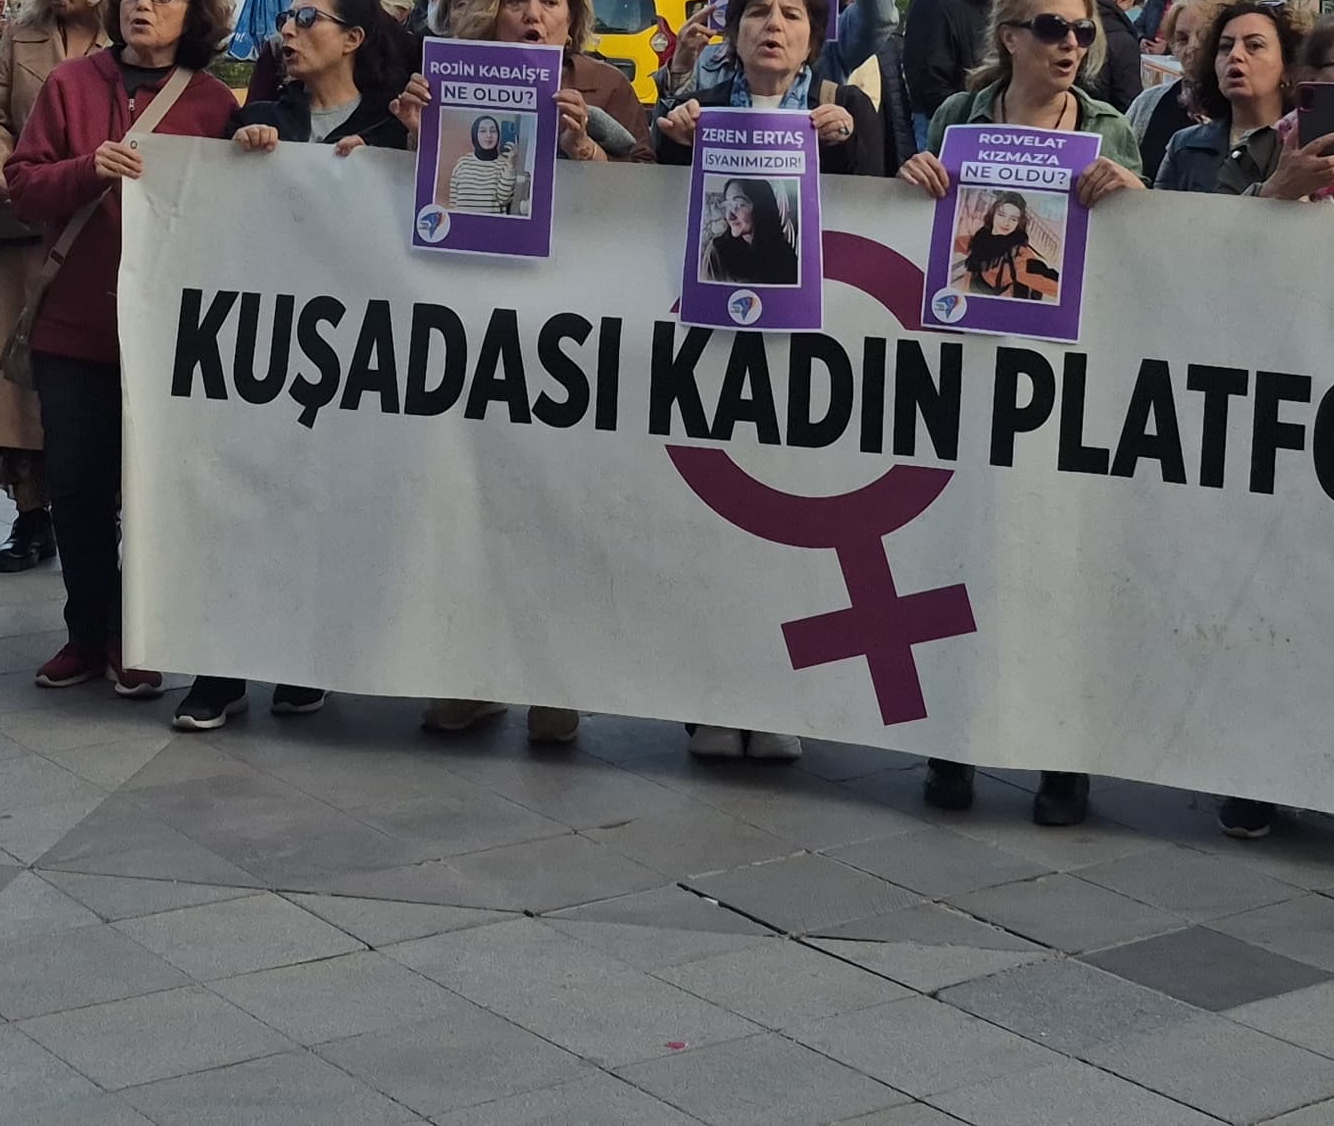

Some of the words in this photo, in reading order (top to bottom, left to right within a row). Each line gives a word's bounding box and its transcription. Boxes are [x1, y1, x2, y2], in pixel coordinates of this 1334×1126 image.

[430, 60, 475, 77] ROJİN
[479, 65, 551, 83] KABAİŞ'E
[444, 85, 468, 100] NE
[473, 87, 533, 105] OLDU?
[702, 127, 747, 144] ZEREN
[752, 131, 805, 149] ERTAŞ
[978, 133, 1067, 149] ROJVELAT
[977, 150, 1060, 165] KIZMAZ'A
[965, 165, 991, 178] NE
[998, 167, 1067, 184] OLDU?
[170, 287, 622, 429] KUŞADASI
[647, 320, 966, 461] KADIN
